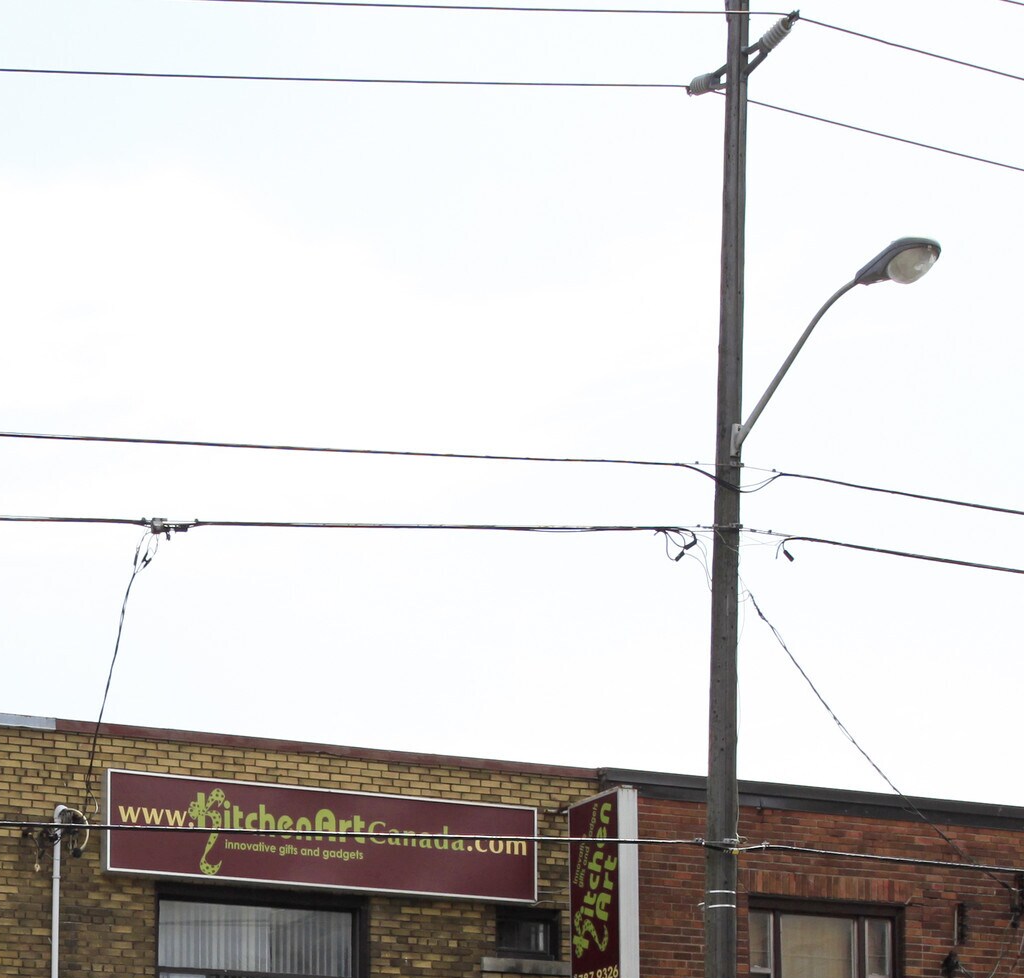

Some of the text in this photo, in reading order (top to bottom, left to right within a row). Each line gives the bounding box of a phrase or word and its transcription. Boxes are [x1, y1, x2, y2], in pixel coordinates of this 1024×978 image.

[224, 838, 364, 862] innovative gifts and gadgets
[588, 802, 598, 845] adgets
[573, 802, 612, 958] Kitchen
[595, 854, 618, 922] Art
